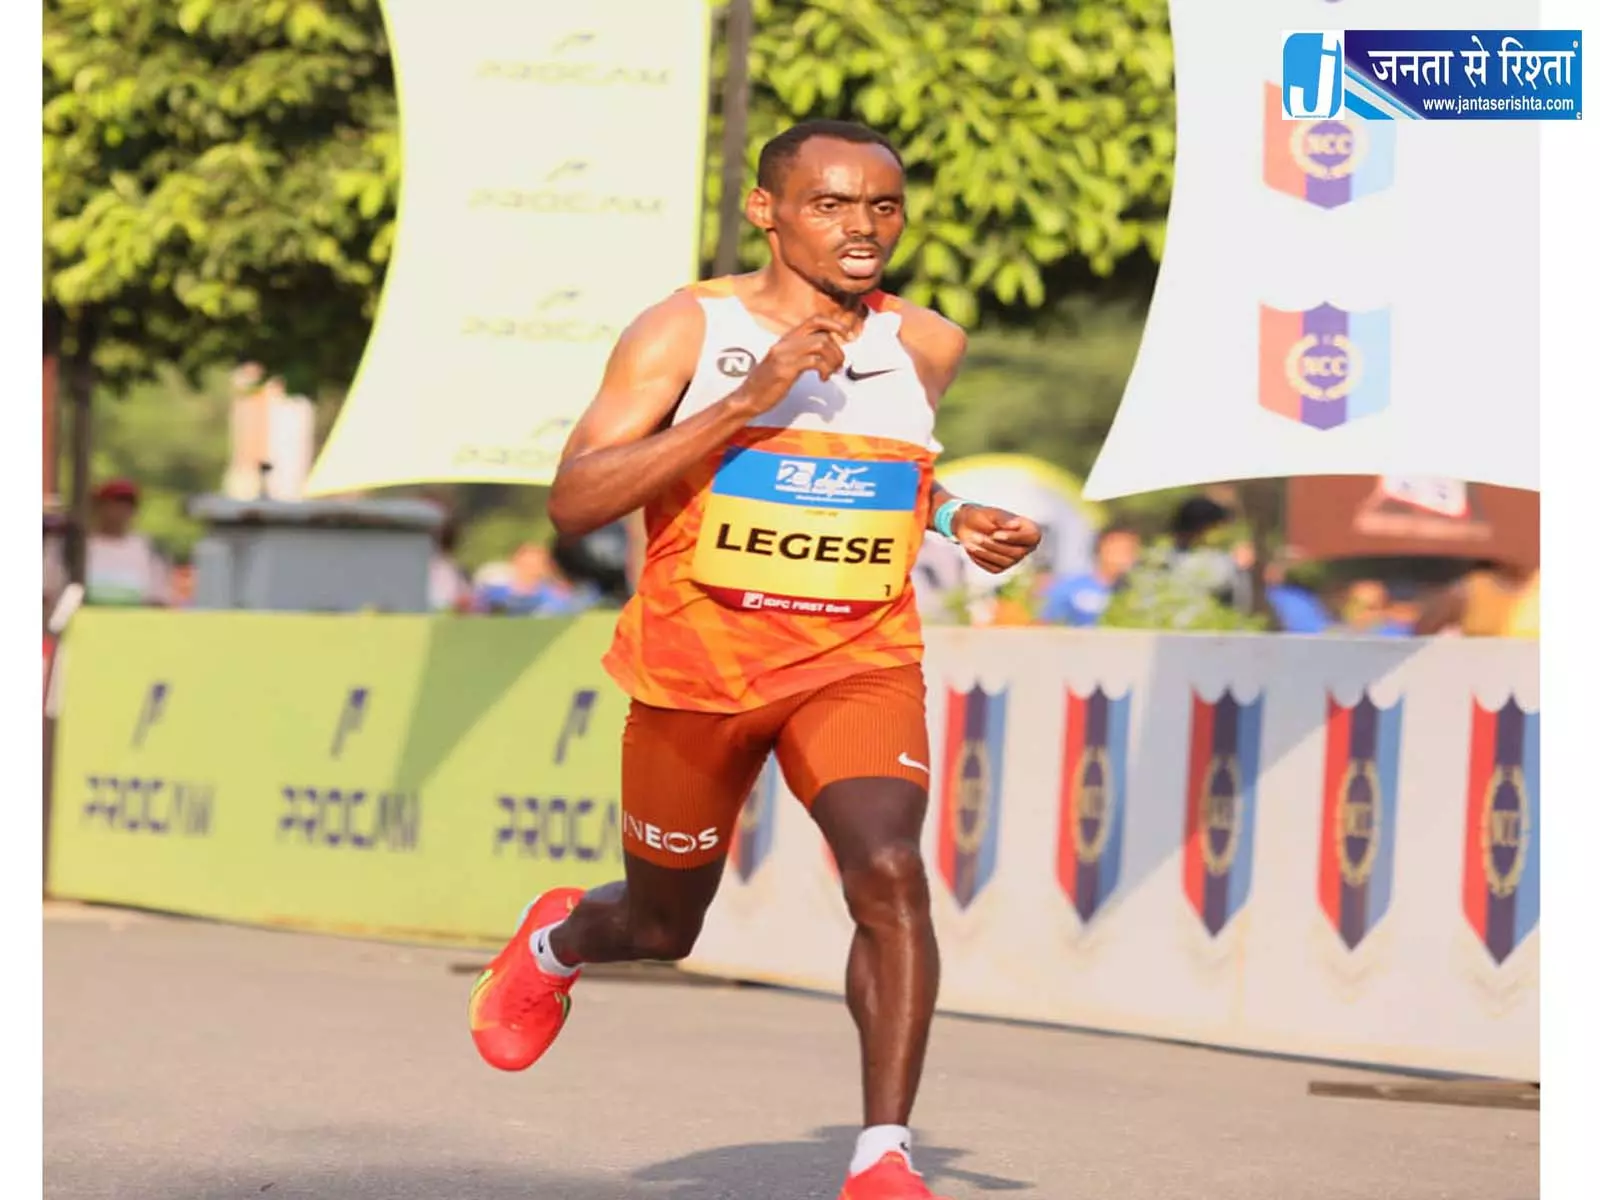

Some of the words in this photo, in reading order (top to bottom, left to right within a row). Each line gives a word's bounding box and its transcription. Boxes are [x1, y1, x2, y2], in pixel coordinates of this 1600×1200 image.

[715, 523, 895, 565] LEGESE
[883, 585, 892, 597] 1
[623, 810, 719, 853] INEOS
